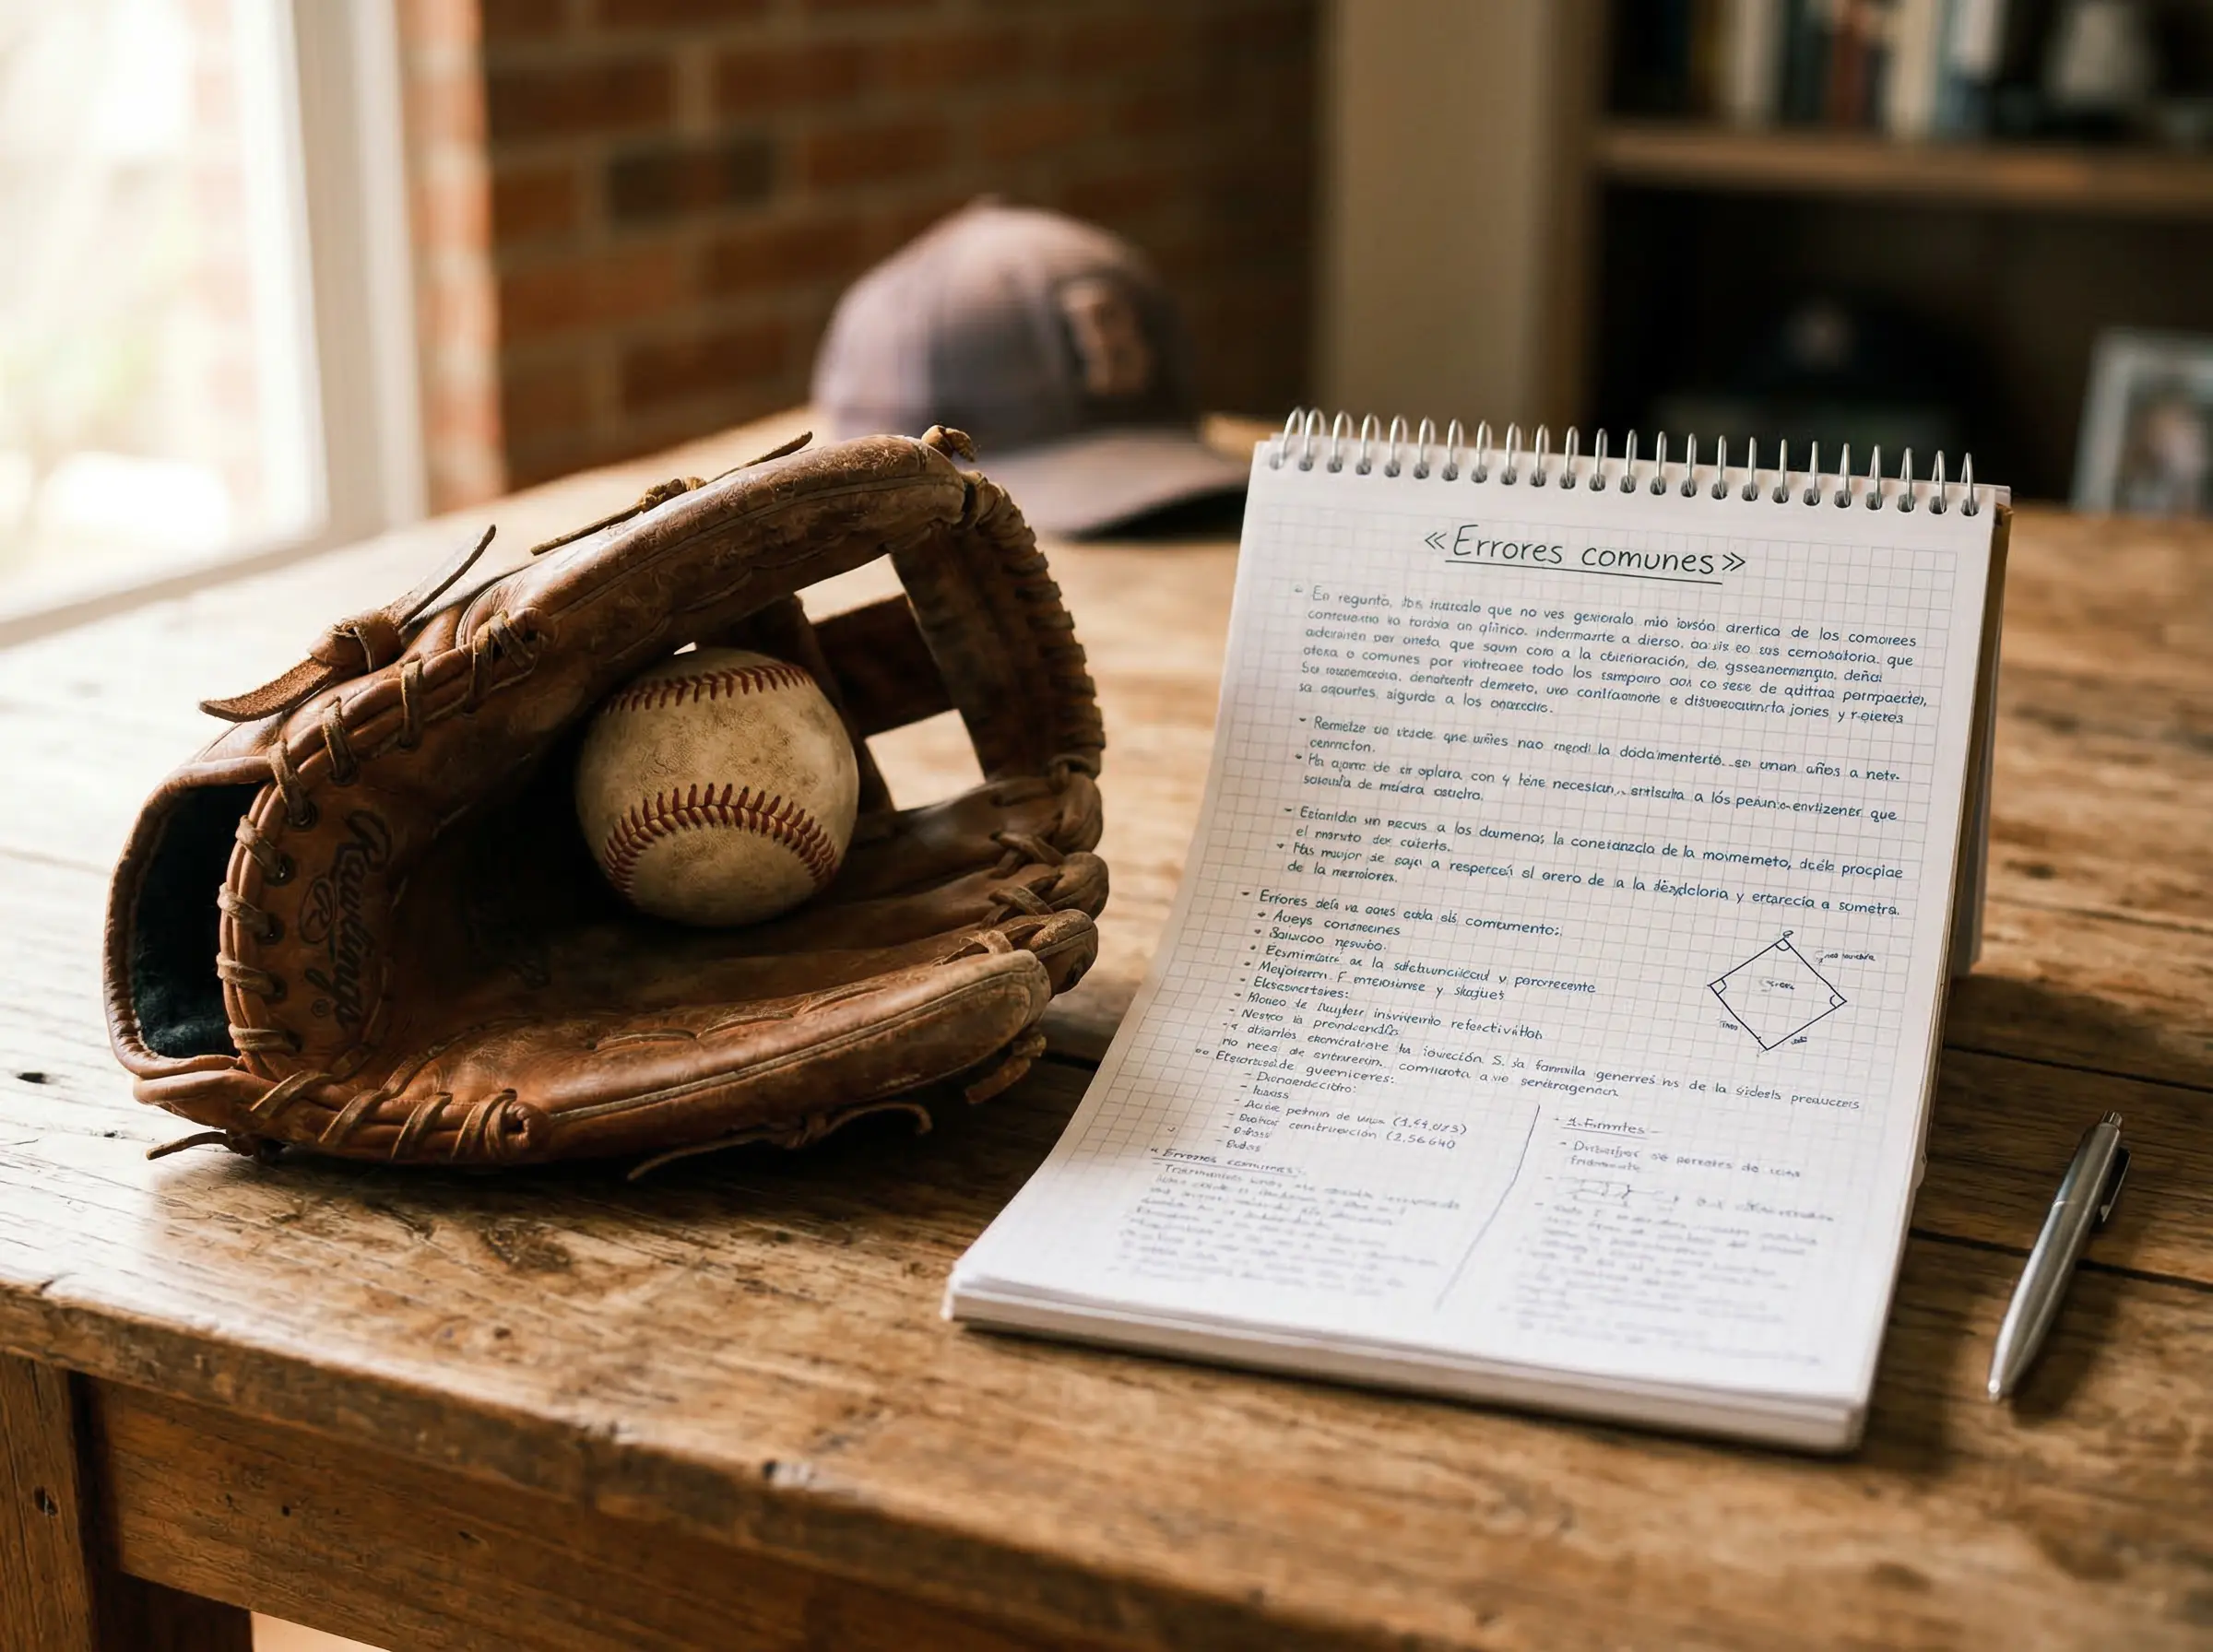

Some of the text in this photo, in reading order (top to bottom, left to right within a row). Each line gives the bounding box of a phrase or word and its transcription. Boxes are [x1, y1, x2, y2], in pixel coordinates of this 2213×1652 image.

[1488, 607, 1511, 619] que
[1521, 608, 1536, 617] no
[1792, 626, 1808, 638] de
[1820, 628, 1839, 641] los
[1450, 641, 1473, 653] que
[1562, 650, 1570, 658] a
[1580, 647, 1591, 659] la
[1888, 656, 1912, 668] que
[1363, 652, 1419, 664] comunes
[1573, 666, 1592, 678] los
[1760, 682, 1776, 693] de
[1446, 696, 1454, 704] a
[1464, 693, 1481, 707] los
[1838, 712, 1845, 723] y
[1598, 744, 1610, 755] la
[1358, 778, 1372, 789] de
[1374, 761, 1390, 773] de
[1471, 773, 1494, 782] con
[1695, 794, 1703, 802] a
[1871, 810, 1897, 822] que
[1296, 826, 1308, 836] el
[1455, 821, 1471, 835] los
[1554, 832, 1564, 844] la
[1662, 844, 1677, 856] de
[1684, 845, 1695, 857] la
[1288, 860, 1303, 872] de
[1314, 862, 1325, 875] la
[1431, 861, 1439, 869] a
[1588, 873, 1604, 886] de
[1633, 877, 1645, 891] la
[1737, 893, 1744, 903] y
[304, 811, 388, 1026] Rawlings
[1372, 957, 1383, 968] la
[1436, 987, 1443, 998] y
[1689, 1080, 1706, 1091] de
[1716, 1083, 1726, 1092] la
